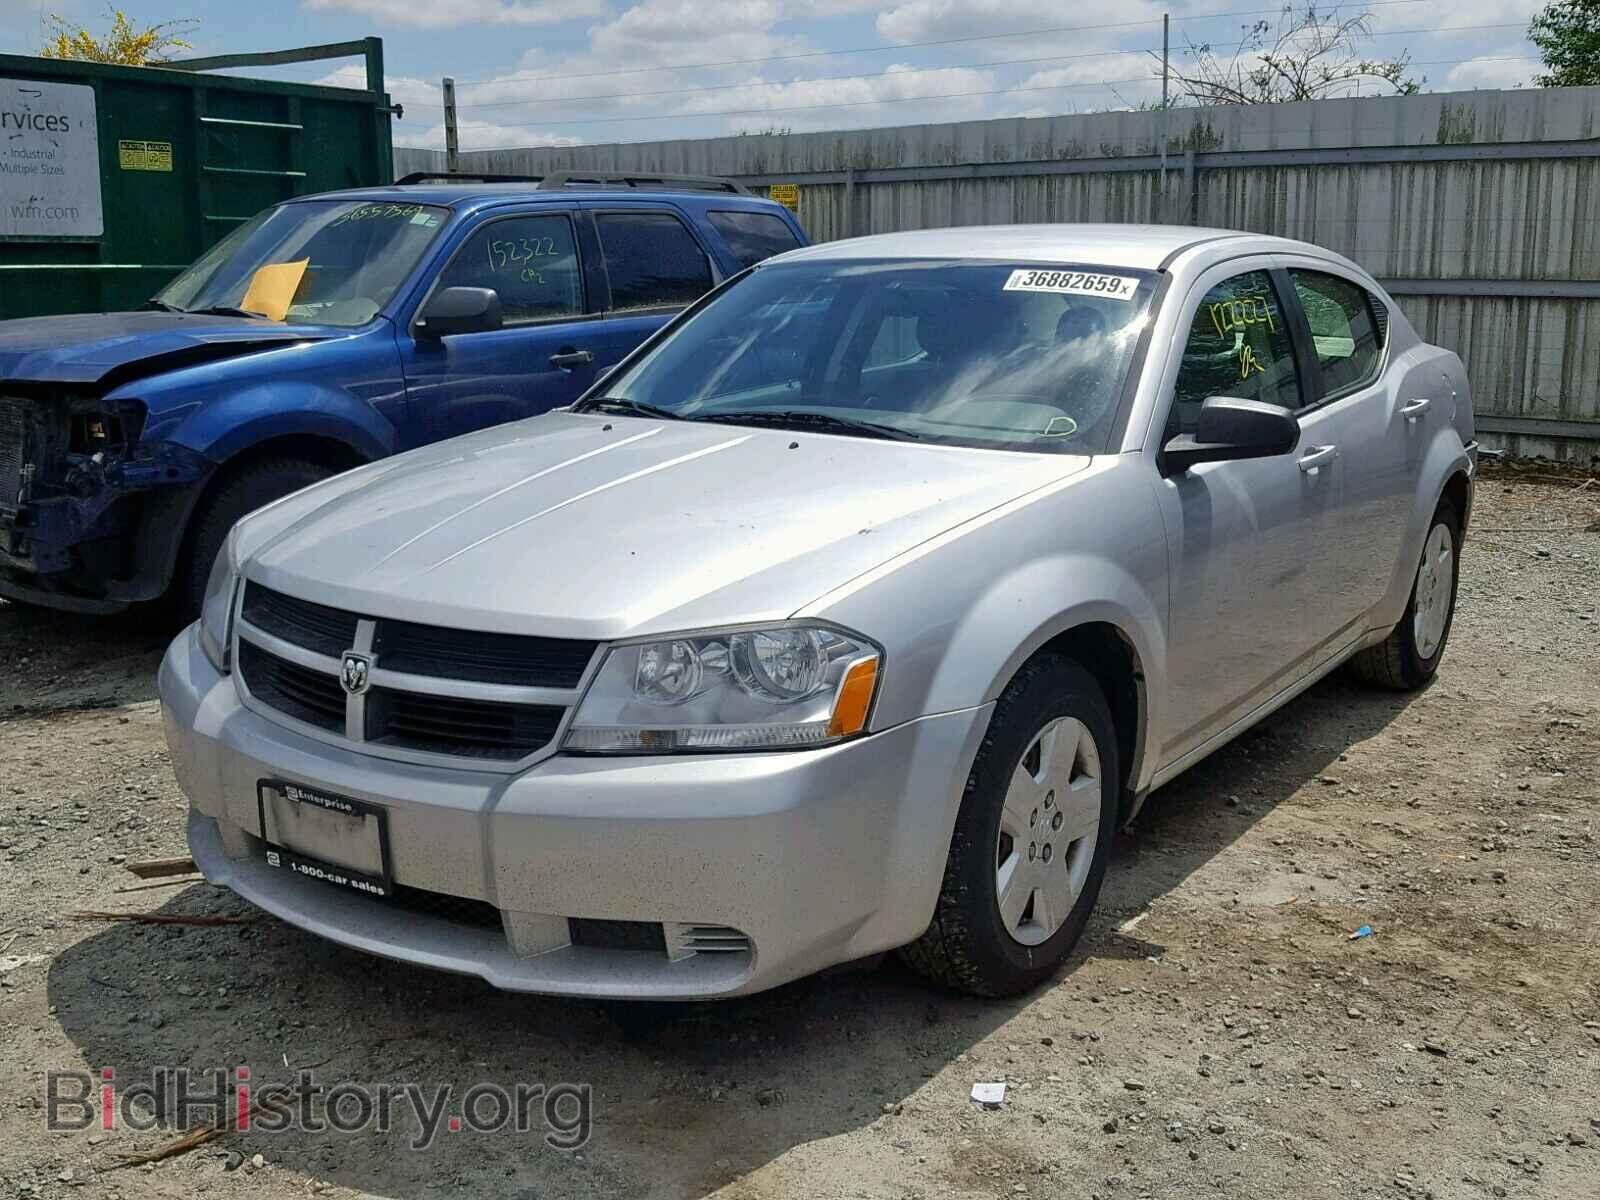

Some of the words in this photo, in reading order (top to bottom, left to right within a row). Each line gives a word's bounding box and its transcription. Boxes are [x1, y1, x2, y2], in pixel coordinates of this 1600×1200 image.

[11, 148, 56, 160] Industrial
[41, 163, 65, 175] Sizes
[1022, 271, 1122, 293] 36882659
[298, 789, 352, 811] Enterprise
[291, 862, 348, 885] 1-800-car
[351, 880, 385, 896] sales
